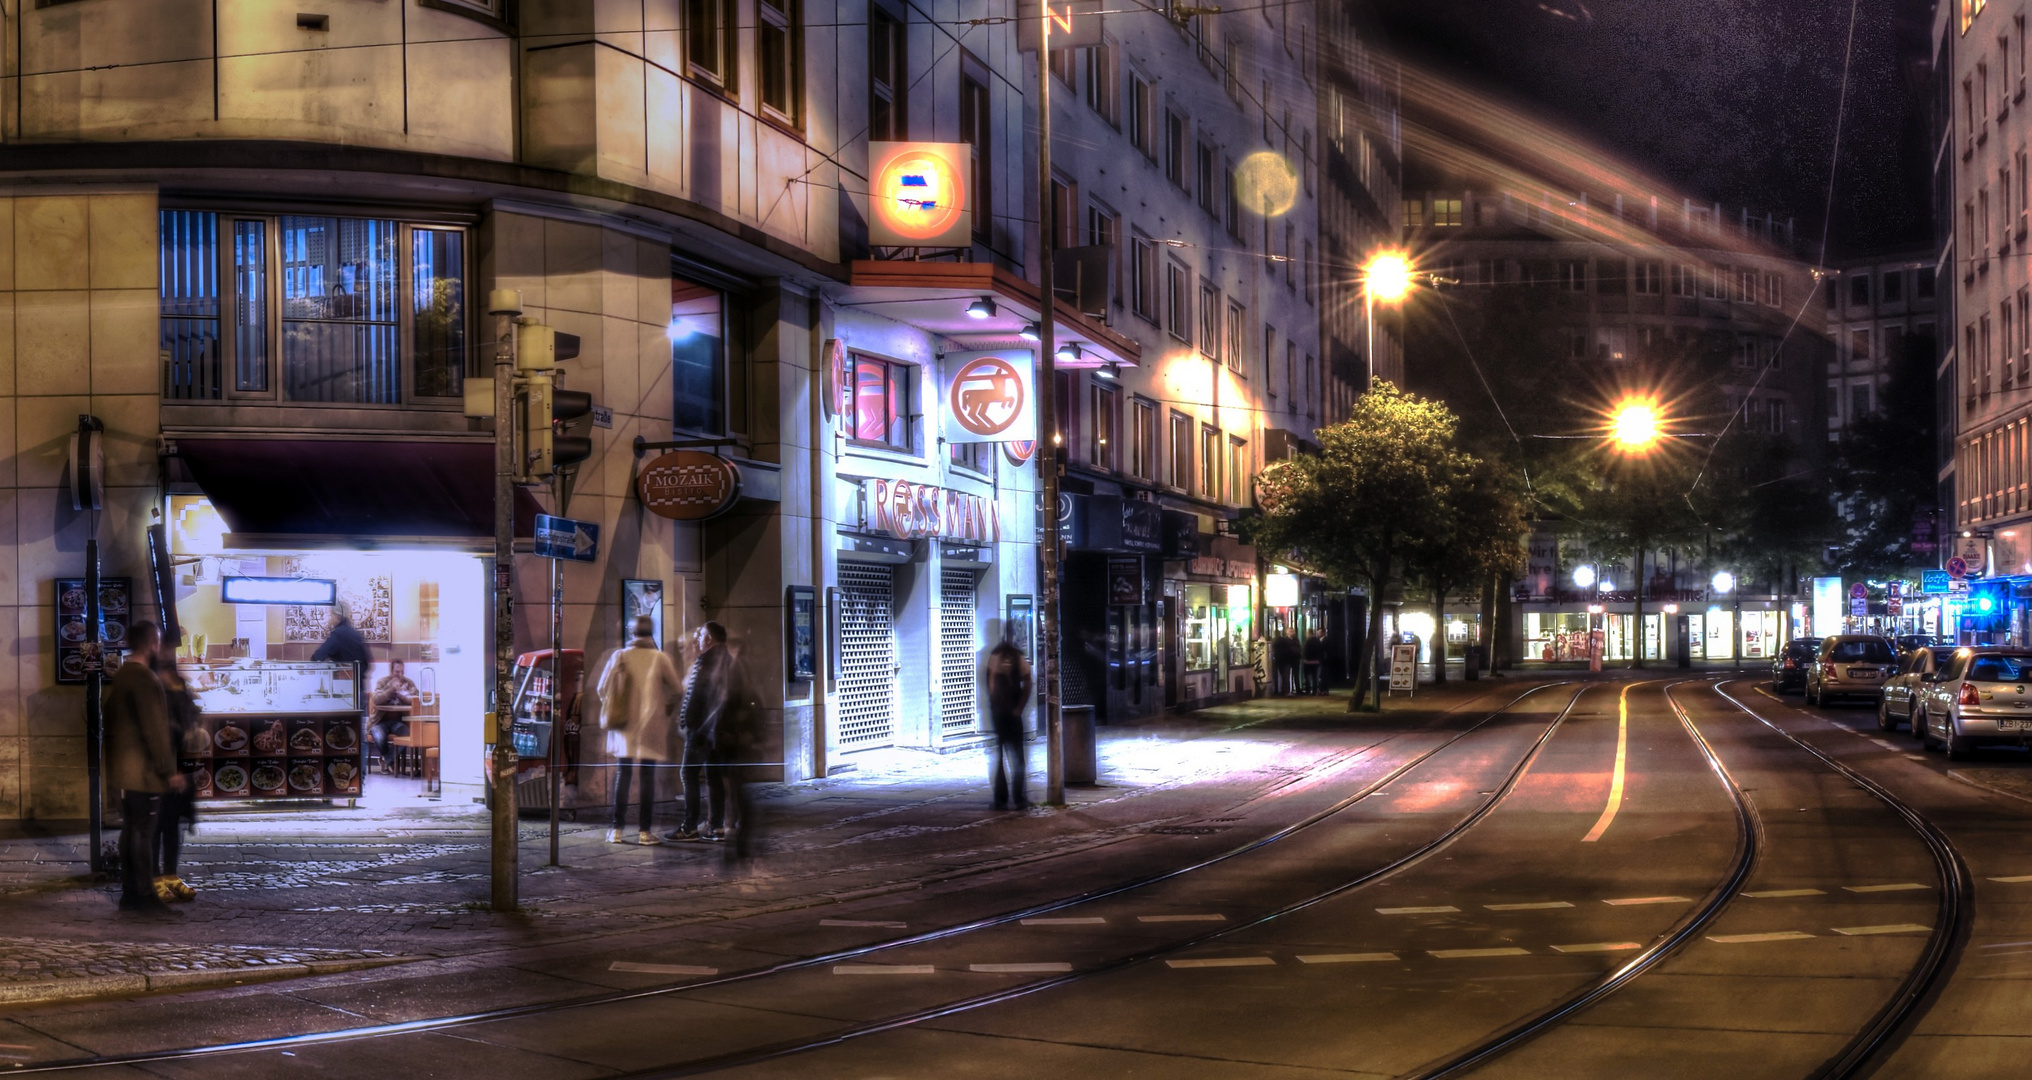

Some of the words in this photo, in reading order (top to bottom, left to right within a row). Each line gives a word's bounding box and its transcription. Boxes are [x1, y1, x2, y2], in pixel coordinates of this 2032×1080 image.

[655, 473, 714, 487] MOZAIK
[664, 487, 703, 496] Bistro
[876, 479, 1001, 543] ROSSMANN
